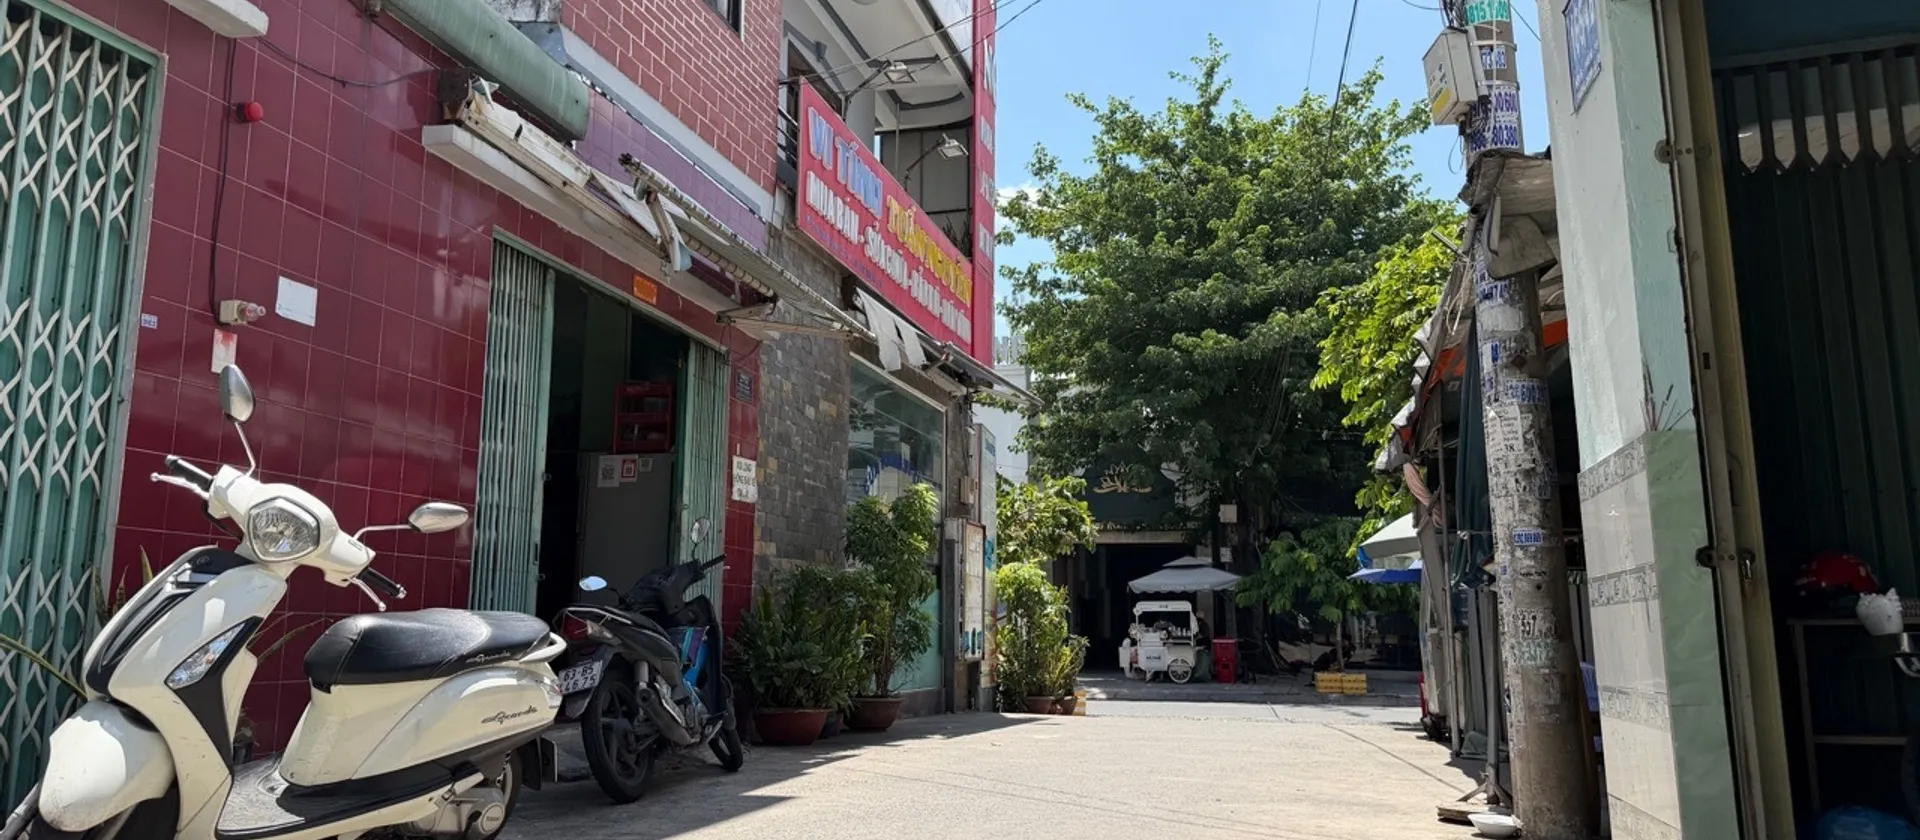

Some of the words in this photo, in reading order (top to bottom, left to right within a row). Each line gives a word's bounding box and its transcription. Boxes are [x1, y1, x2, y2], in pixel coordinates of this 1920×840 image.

[807, 106, 833, 171] VI
[805, 170, 836, 226] MUA
[834, 195, 860, 245] BÁN
